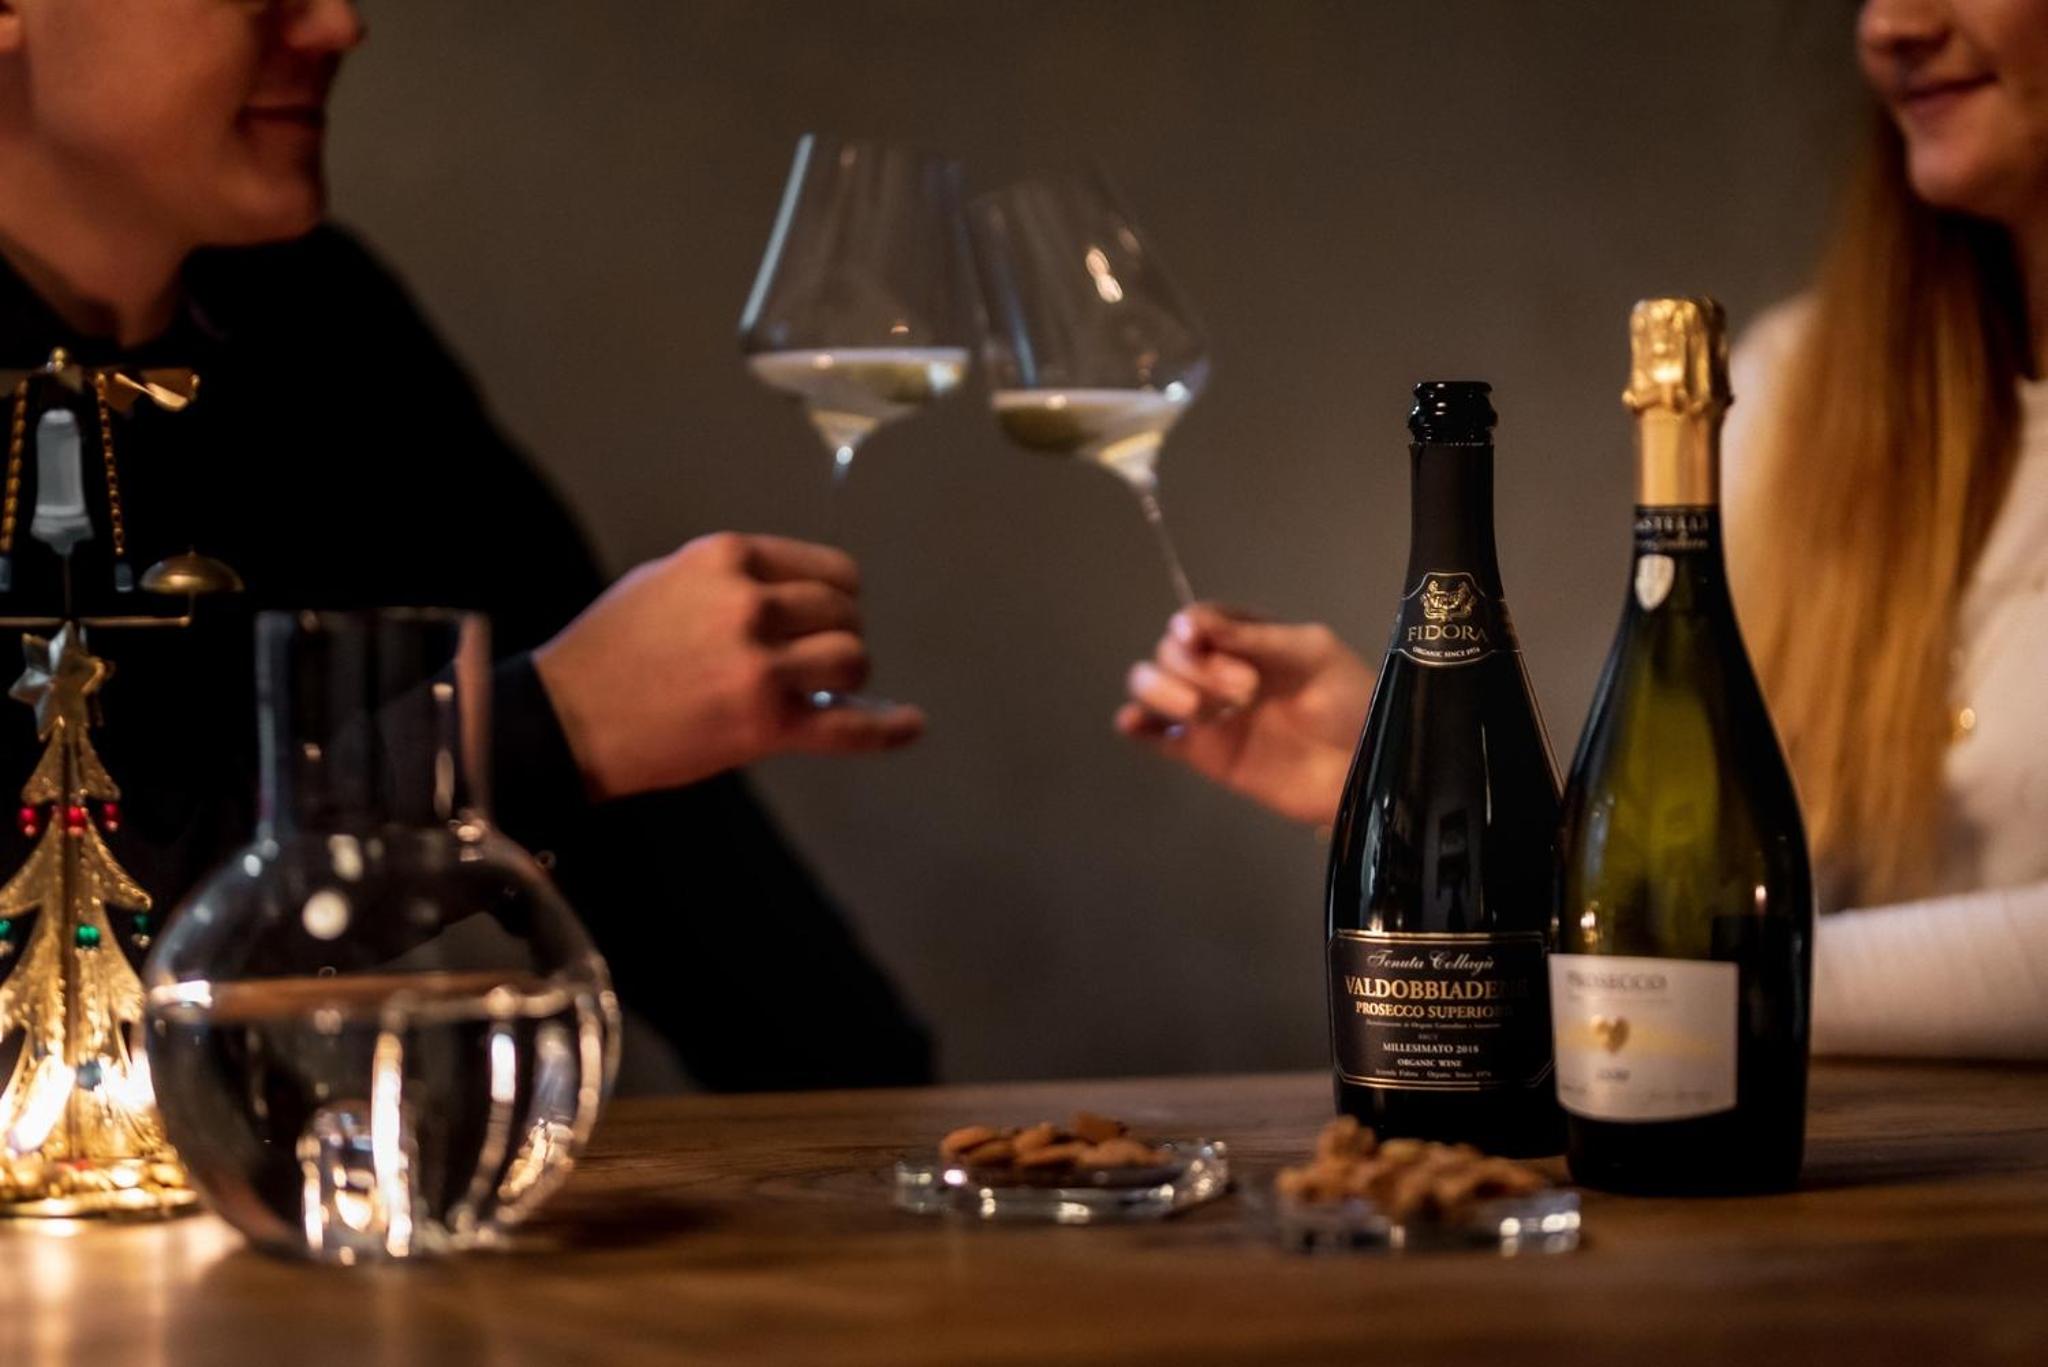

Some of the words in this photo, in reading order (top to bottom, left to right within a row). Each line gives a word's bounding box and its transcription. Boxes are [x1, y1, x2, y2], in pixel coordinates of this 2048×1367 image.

[1408, 624, 1488, 642] FIDORA
[1367, 950, 1425, 969] Tenuta
[1356, 1001, 1425, 1018] PROSECCO
[1382, 1042, 1453, 1054] MILLESIMATO
[1397, 1059, 1435, 1067] ORGANIC
[1438, 1060, 1463, 1068] WINE
